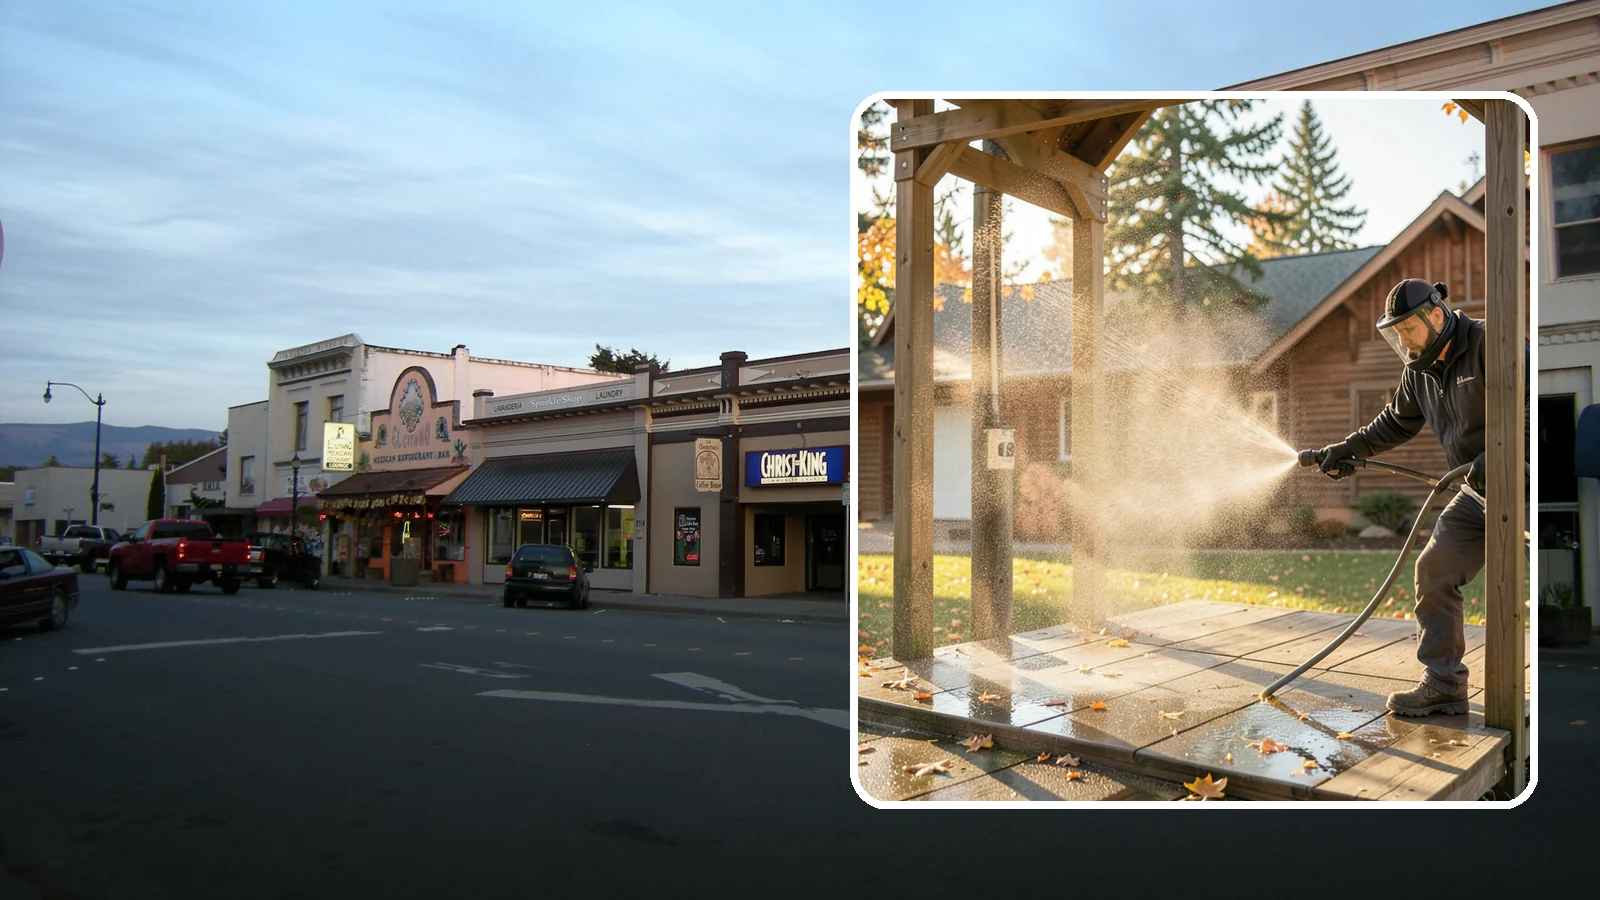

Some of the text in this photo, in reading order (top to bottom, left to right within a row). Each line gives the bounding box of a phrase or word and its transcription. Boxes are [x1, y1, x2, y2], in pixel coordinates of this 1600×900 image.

[562, 394, 582, 404] Shop
[595, 389, 623, 400] LAUNDRY
[493, 402, 522, 412] LAVANDERIA
[397, 451, 433, 462] RESTAURANT
[437, 450, 450, 459] BAR
[761, 450, 827, 478] CHRIST KING
